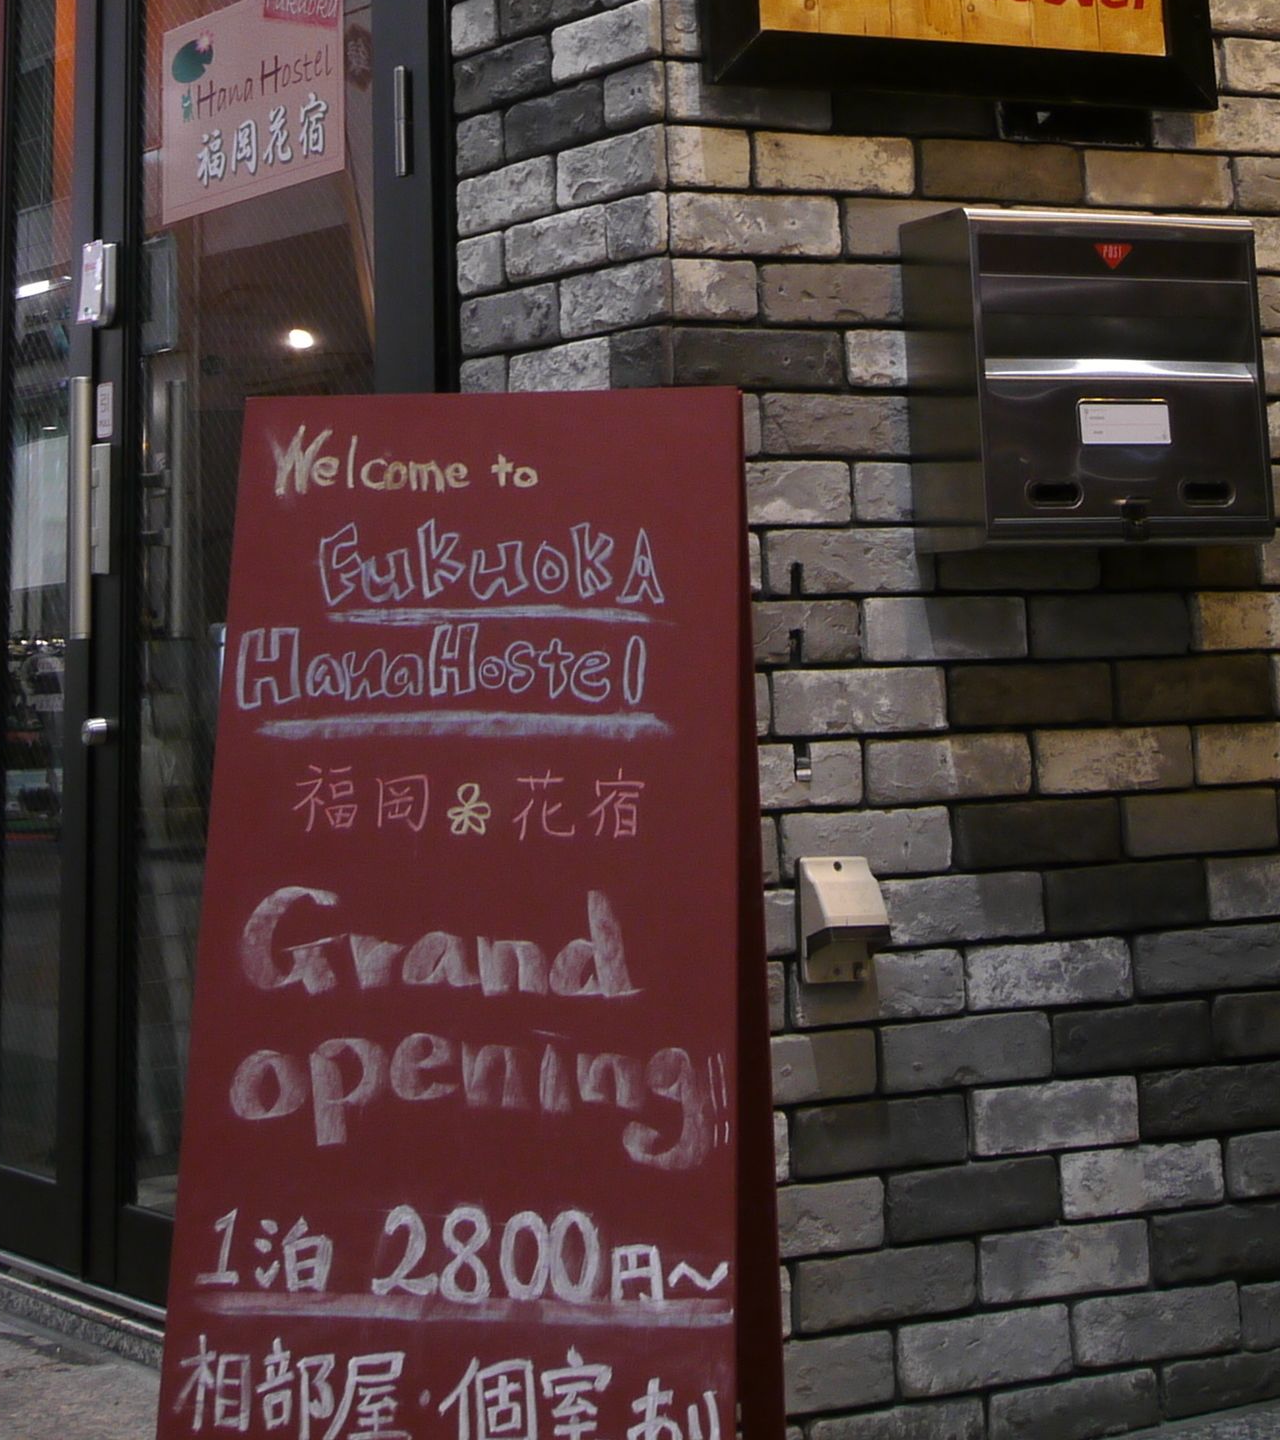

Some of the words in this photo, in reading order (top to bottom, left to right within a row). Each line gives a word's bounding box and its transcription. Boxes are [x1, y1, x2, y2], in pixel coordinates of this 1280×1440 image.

[197, 78, 253, 119] Hana
[261, 45, 333, 96] Hostel
[197, 93, 328, 187] 福岡花宿
[273, 425, 469, 498] Welcome
[492, 455, 538, 489] to
[293, 763, 429, 832] 福岡
[512, 767, 645, 841] 花宿
[238, 885, 645, 999] Grand
[194, 1207, 333, 1294] 1泊
